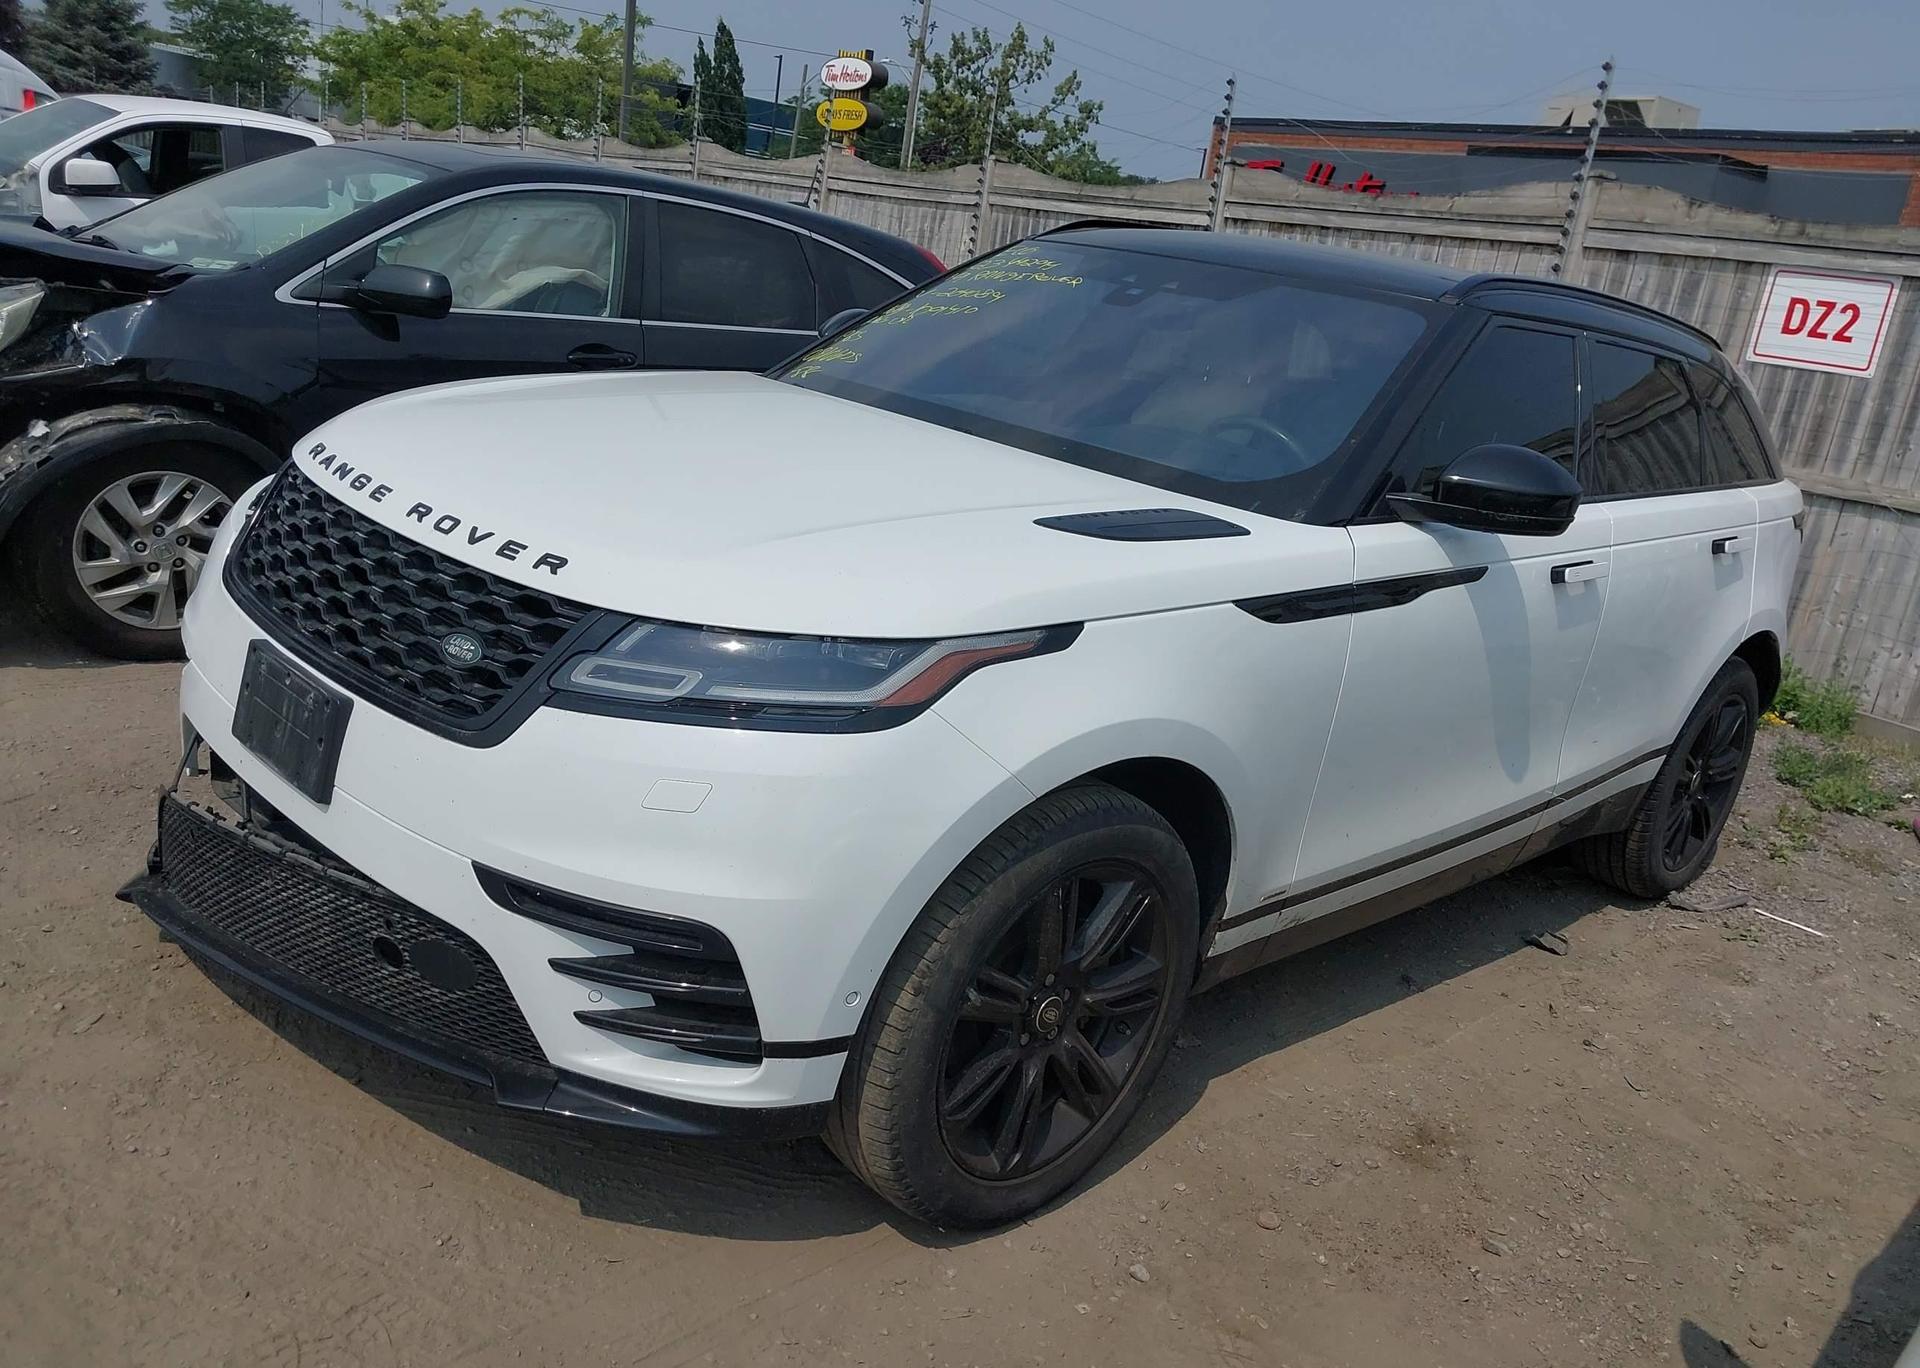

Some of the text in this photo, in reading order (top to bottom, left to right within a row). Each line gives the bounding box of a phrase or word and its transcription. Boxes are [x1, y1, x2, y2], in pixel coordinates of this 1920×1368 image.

[825, 63, 868, 83] Tim Hortons
[820, 108, 864, 121] ALAYS FRESH
[1780, 296, 1861, 343] DZ2
[308, 442, 569, 576] RANGE ROVER
[449, 635, 472, 650] LAND
[447, 644, 473, 661] ROVER
